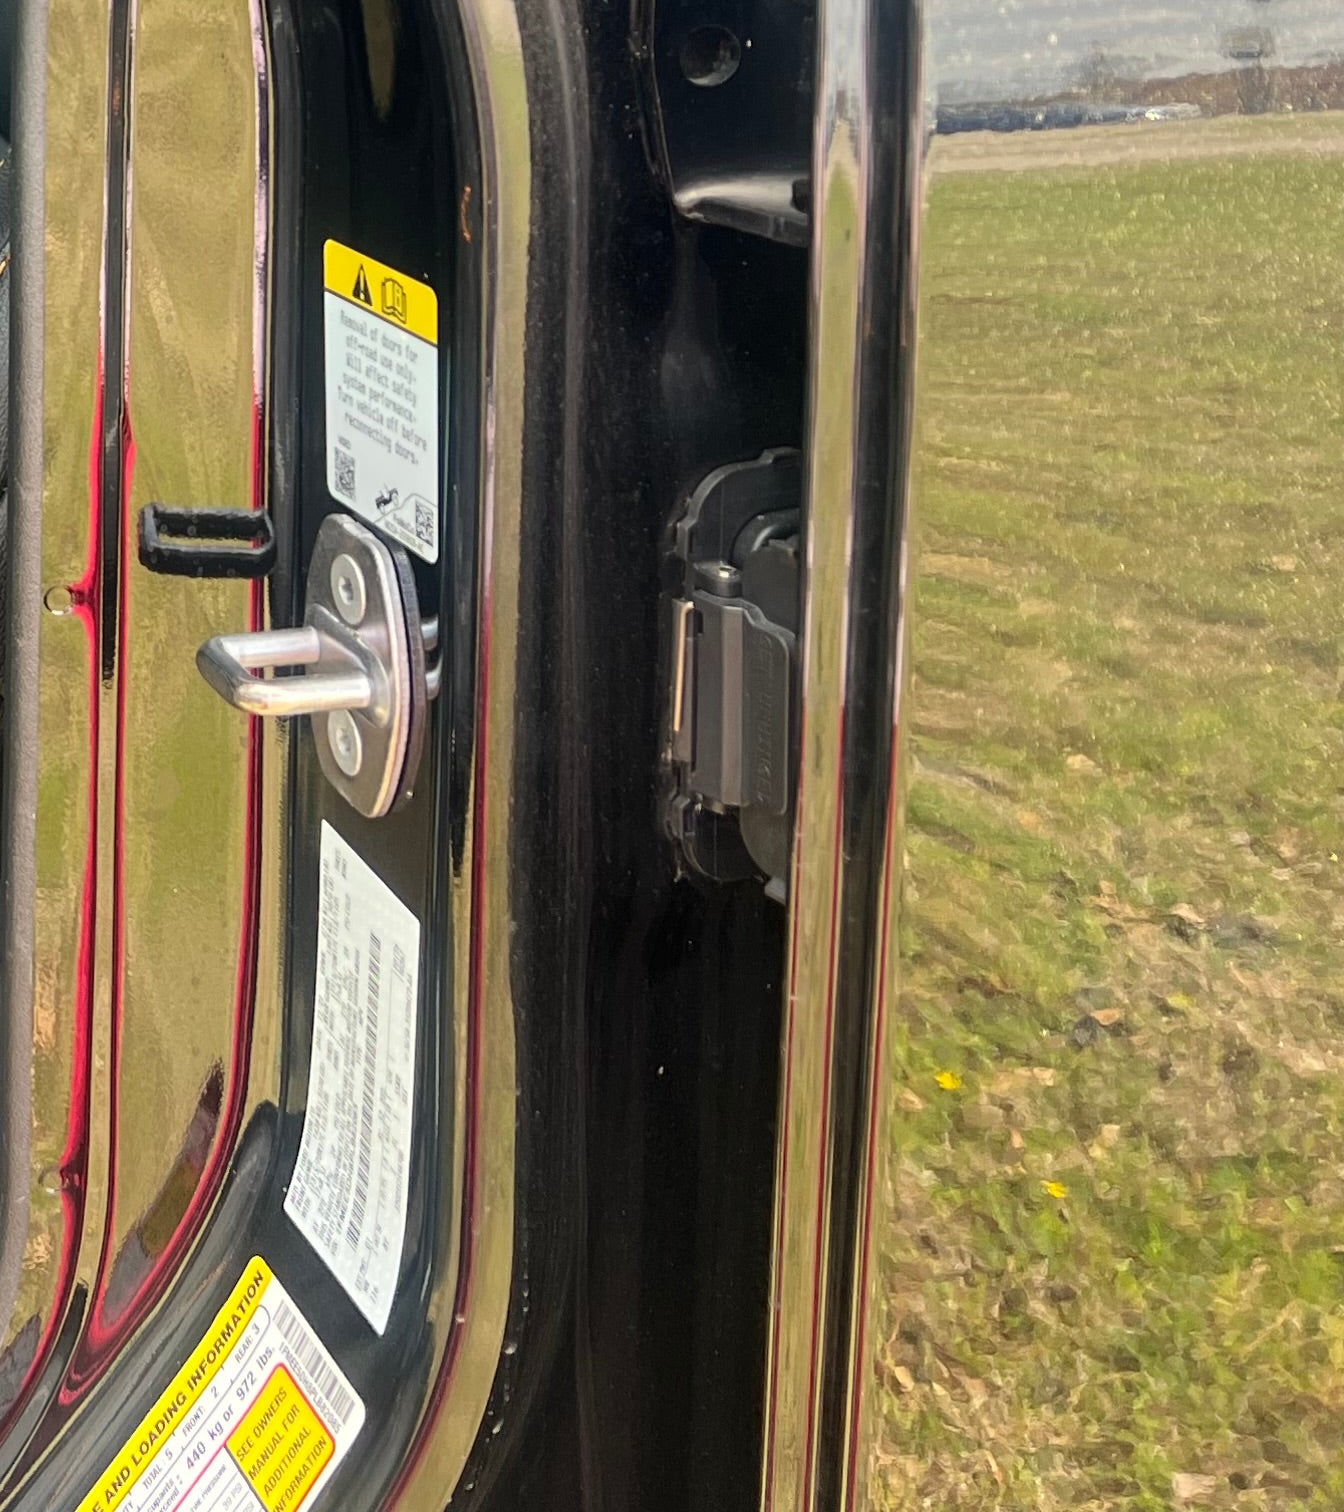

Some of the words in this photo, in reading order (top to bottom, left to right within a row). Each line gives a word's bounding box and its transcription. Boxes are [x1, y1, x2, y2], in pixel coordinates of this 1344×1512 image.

[105, 1466, 131, 1504] AND
[131, 1391, 189, 1466] LOADING
[187, 1270, 264, 1392] INFORMATION
[165, 1448, 173, 1461] 5
[211, 1386, 219, 1399] 2
[235, 1335, 253, 1364] REAR:
[251, 1323, 260, 1335] 3
[186, 1441, 206, 1469] 440
[207, 1421, 224, 1440] kg
[223, 1404, 234, 1422] or
[236, 1371, 257, 1401] 972
[236, 1436, 254, 1462] SEE
[252, 1387, 287, 1438] OWNERS
[248, 1431, 285, 1481] MANUAL
[282, 1403, 300, 1432] FOR
[263, 1427, 311, 1497] ADDITIONAL
